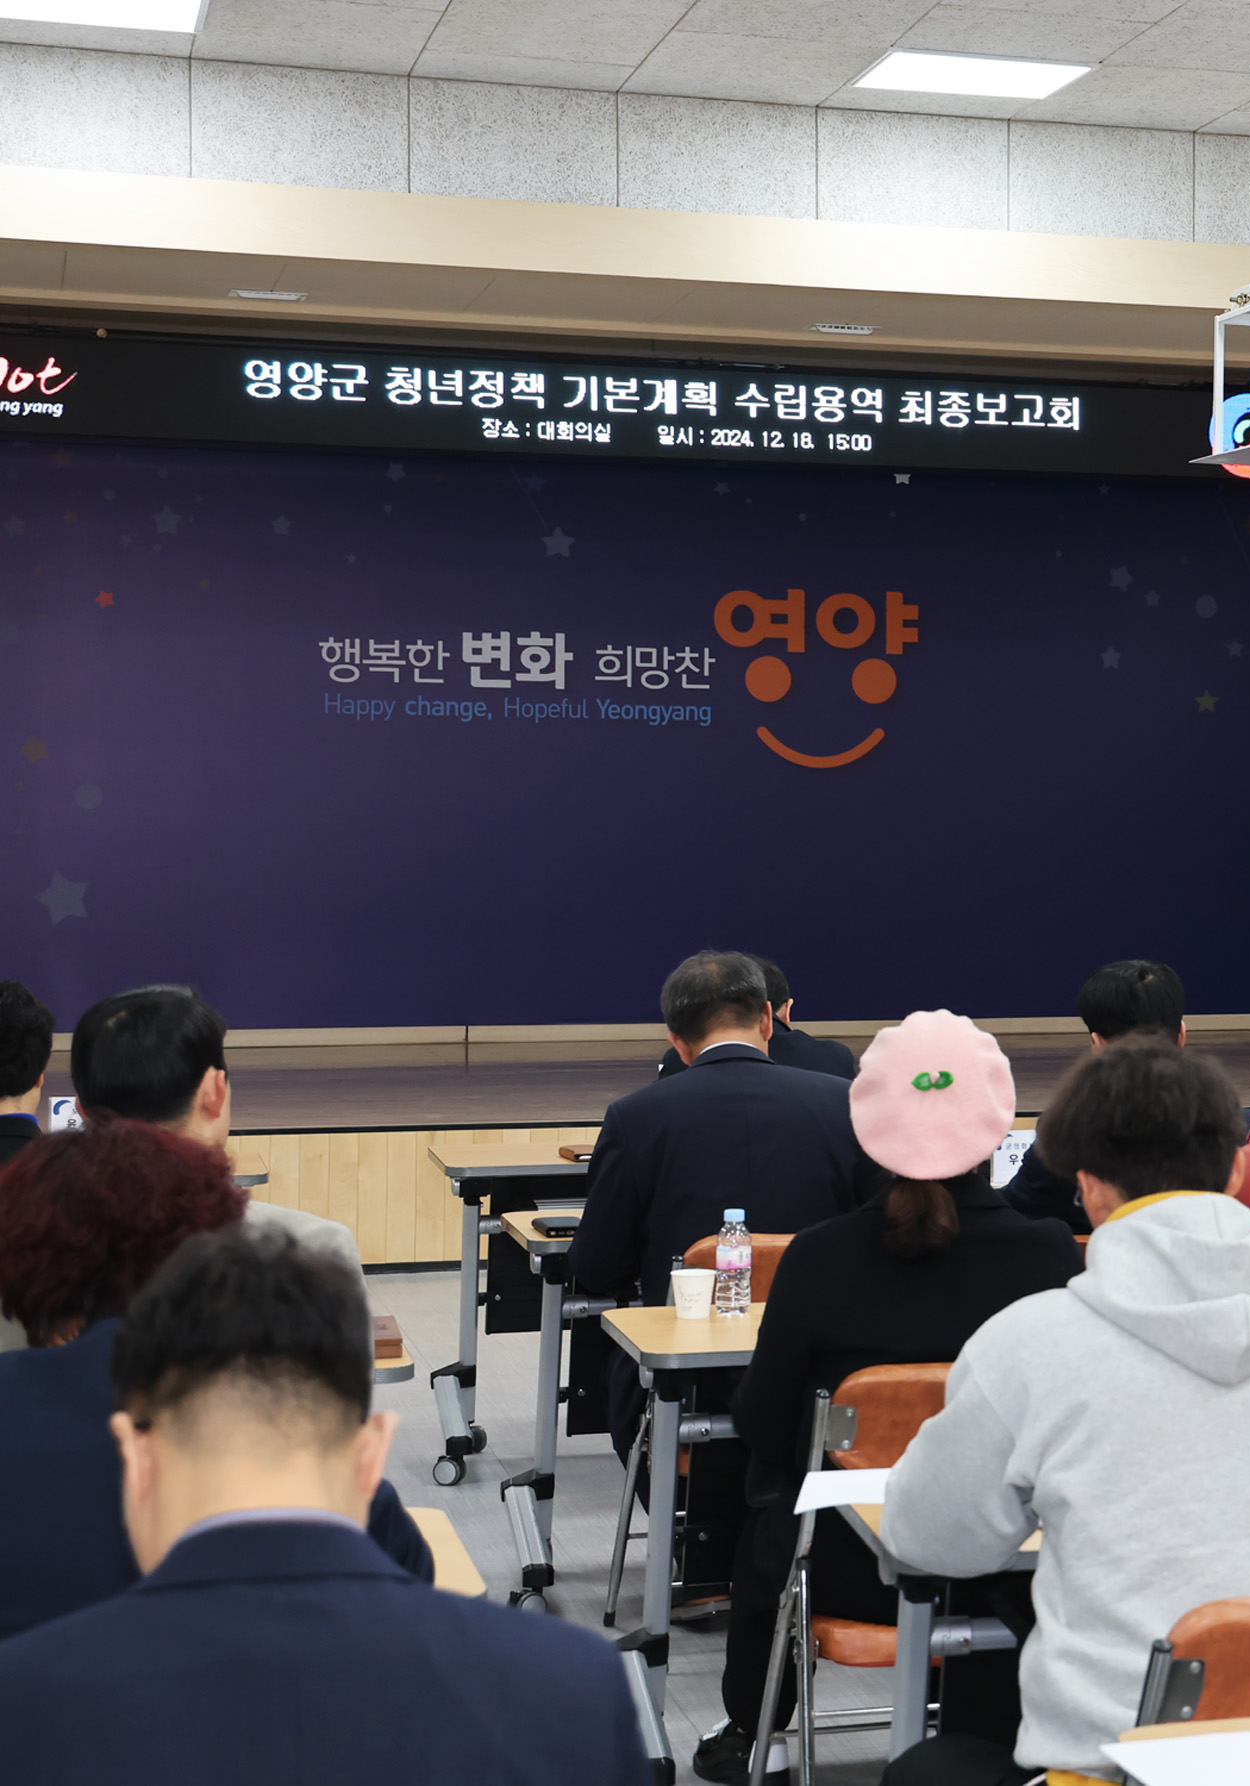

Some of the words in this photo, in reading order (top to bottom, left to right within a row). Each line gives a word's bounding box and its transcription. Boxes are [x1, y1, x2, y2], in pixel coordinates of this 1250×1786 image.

[22, 401, 65, 418] yang
[243, 359, 370, 402] 영양군
[384, 366, 545, 410] 청년정책
[558, 375, 718, 417] 기본계획
[734, 382, 883, 424] 수립용역
[898, 390, 1080, 431] 최종보고회
[481, 417, 521, 439] 장소
[536, 420, 612, 443] 대회의실
[657, 424, 694, 447] 일시
[710, 428, 755, 448] 2024.
[761, 430, 786, 449] 12.
[827, 433, 873, 452] 15:00
[318, 636, 451, 684] 행복한
[461, 630, 574, 690] 변화
[594, 644, 716, 690] 희망찬
[713, 588, 919, 703] 영양
[324, 692, 396, 721] Happy
[404, 694, 493, 723] change,
[504, 696, 589, 724] Hopeful
[595, 697, 712, 727] Yeongyang
